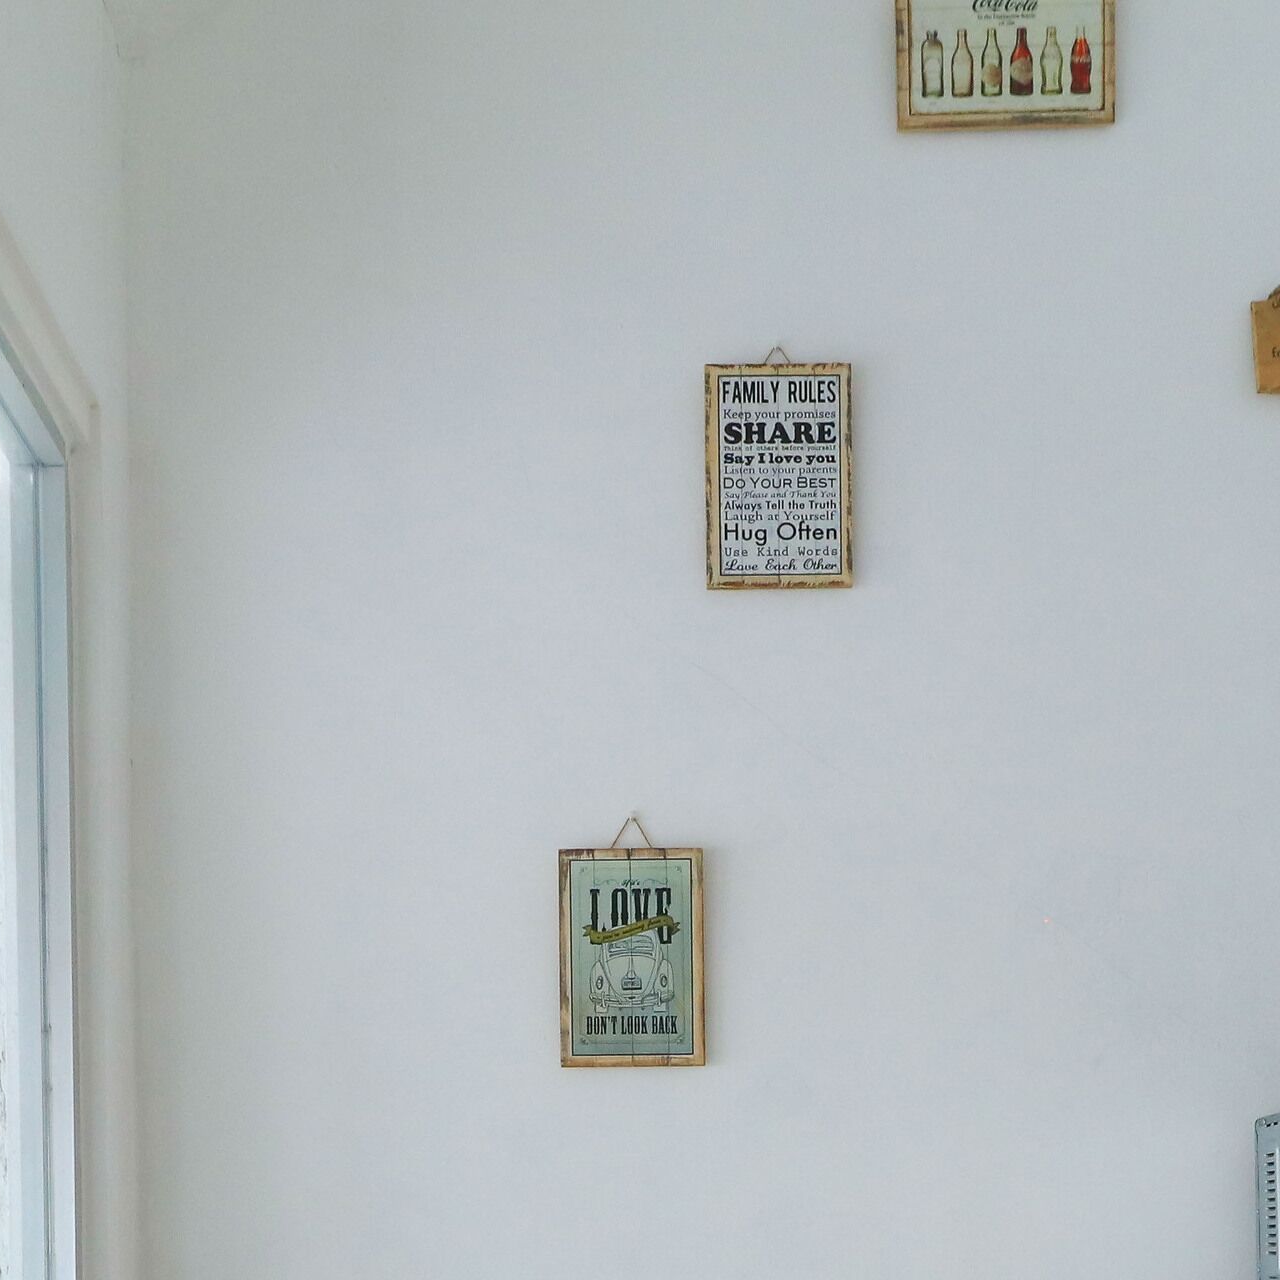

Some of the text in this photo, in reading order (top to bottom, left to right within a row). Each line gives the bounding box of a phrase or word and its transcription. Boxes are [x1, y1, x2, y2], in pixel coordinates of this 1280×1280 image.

[722, 380, 837, 403] FAMILY RULES
[723, 409, 836, 421] Keep your promises
[724, 421, 837, 444] SHARE
[723, 453, 837, 466] Say I love you
[724, 466, 755, 474] Listen
[772, 468, 796, 477] your
[799, 466, 837, 476] parents
[724, 489, 836, 500] Say Please and Thank You
[724, 499, 837, 512] Always Tell the Truth
[725, 510, 836, 524] Laugh at Yourself
[724, 520, 838, 546] Hug Often
[724, 546, 838, 557] Use Kind Words
[724, 558, 837, 571] Love Each Other
[590, 887, 672, 945] LOVE
[586, 1015, 678, 1035] DON'T LOOK BACK
